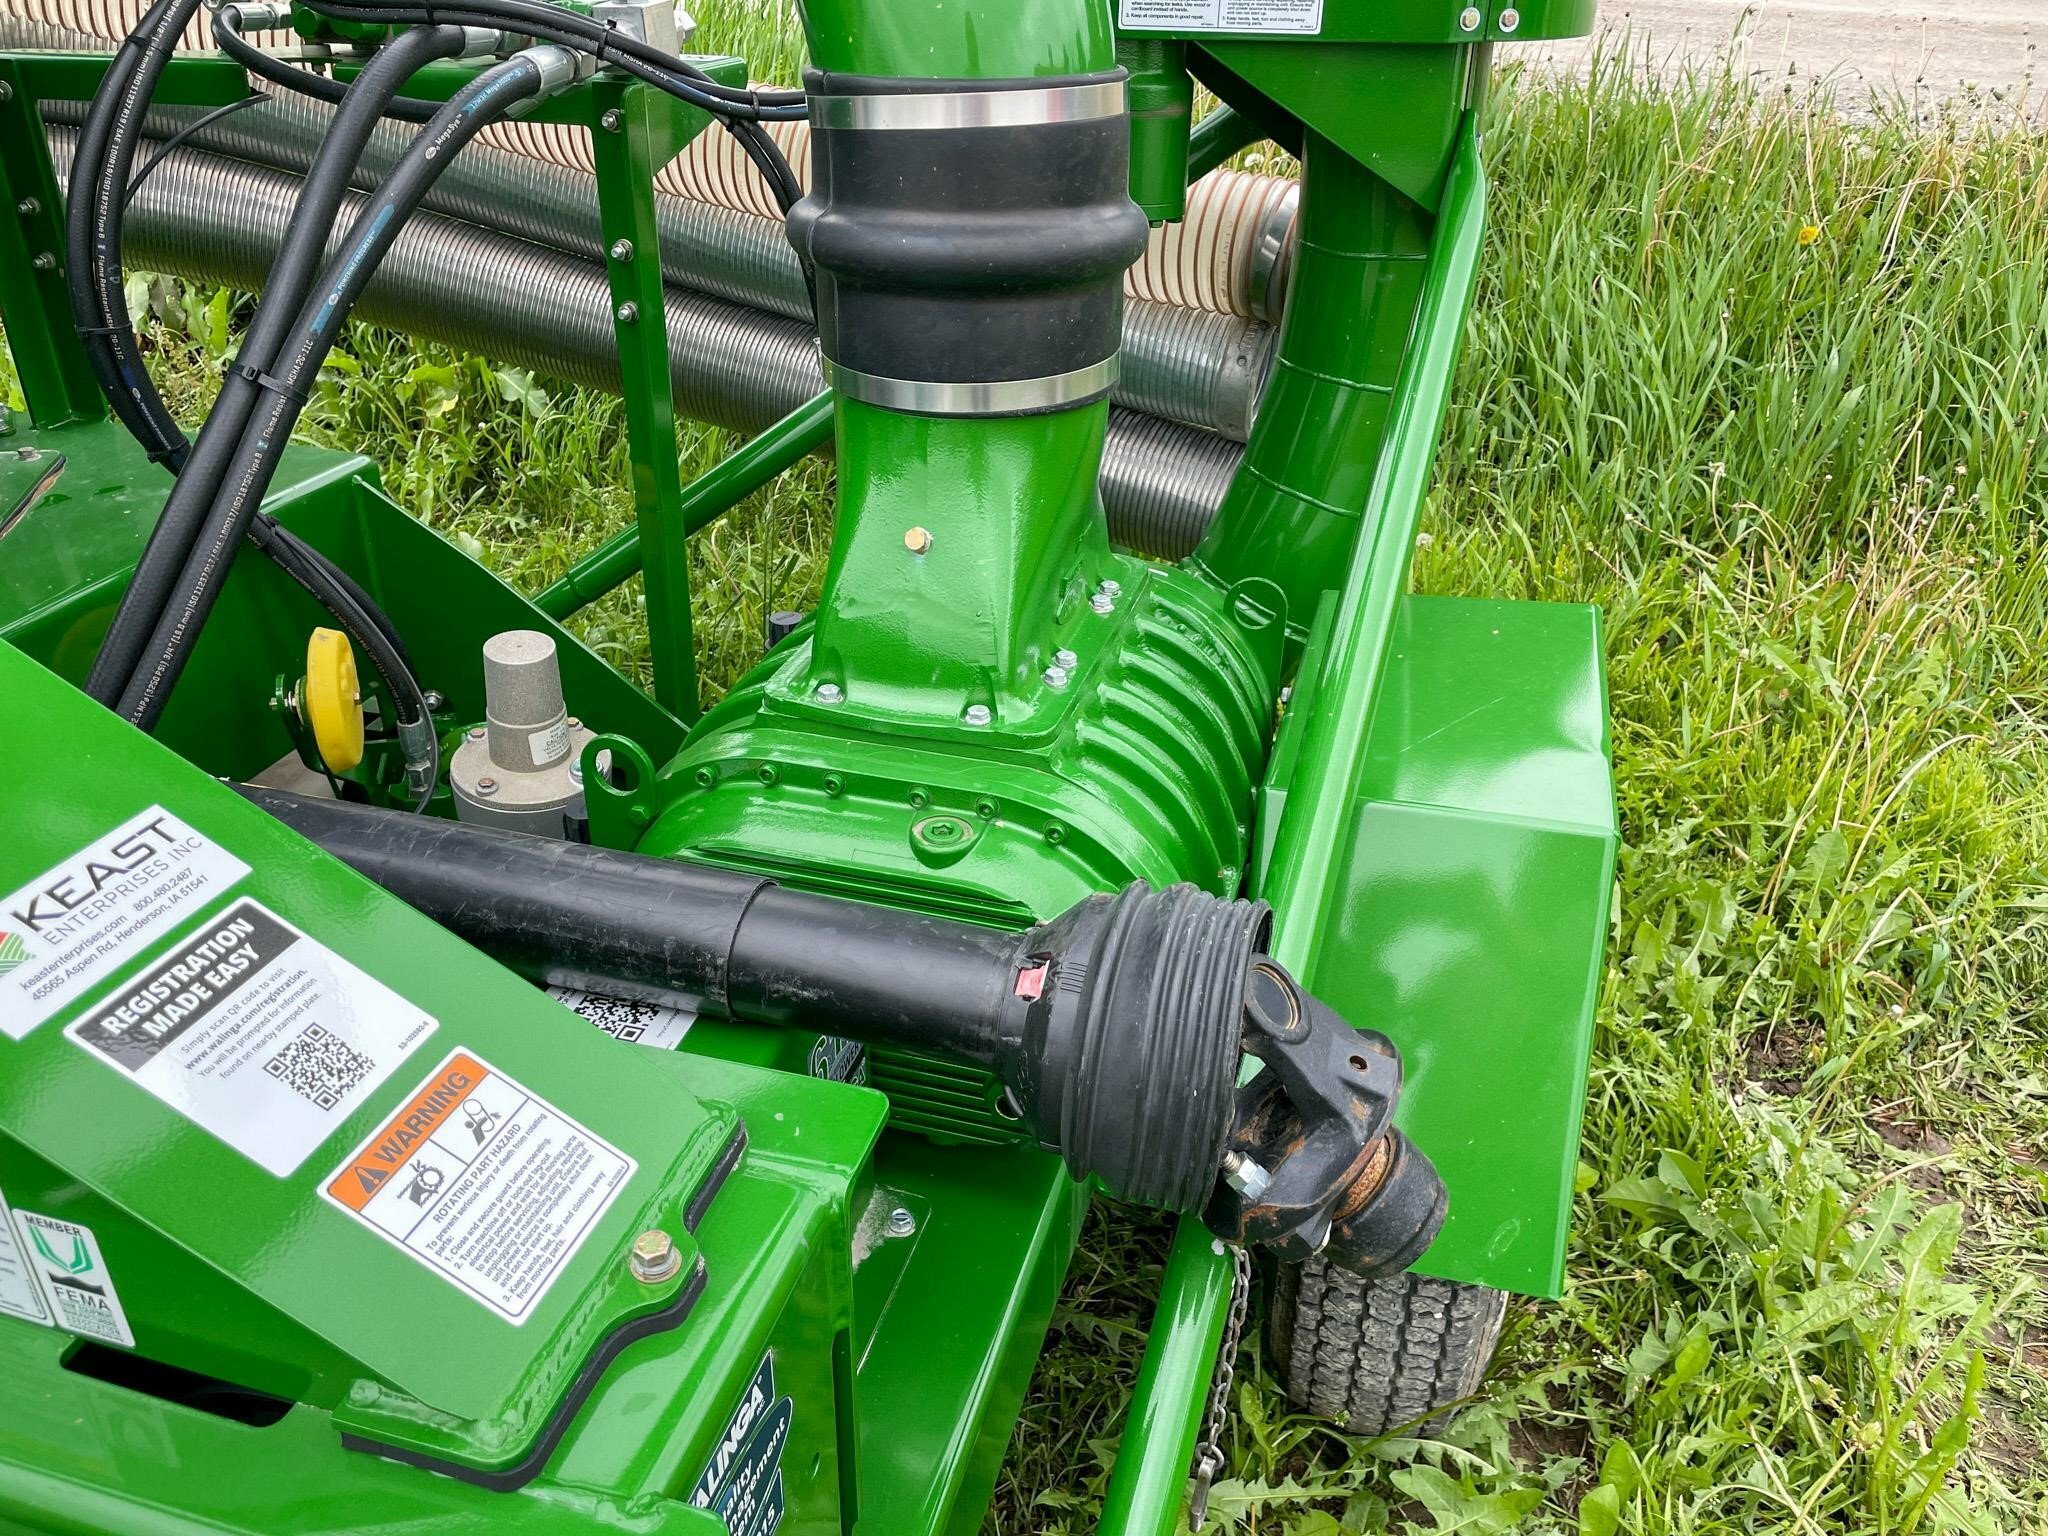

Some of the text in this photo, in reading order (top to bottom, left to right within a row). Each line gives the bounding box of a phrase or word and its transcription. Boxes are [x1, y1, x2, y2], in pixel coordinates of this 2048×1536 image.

[124, 84, 139, 109] 11237
[132, 71, 144, 85] ISO
[97, 215, 106, 232] Type
[99, 190, 109, 215] 18752
[99, 277, 110, 312] Resistant
[261, 338, 314, 438] Flame MSHA 2G-11C
[187, 593, 199, 608] ISO
[193, 571, 209, 596] 11237
[237, 472, 254, 497] 18752
[247, 457, 261, 474] Type
[254, 451, 263, 459] B
[11, 817, 174, 931] KEAST
[42, 836, 203, 945] ENTERPRISES INC
[19, 866, 192, 990] keastenterprises.com 800.480.2487
[31, 873, 209, 1001] 45565 Aspen Rd, Henderson, IA 51541
[101, 918, 253, 1034] REGISTRATION
[142, 942, 259, 1037] MADE EASY
[180, 967, 287, 1054] Simply scan QR code to visit
[184, 969, 307, 1069] www.walinga.com/registration.
[197, 977, 318, 1077] You will be prompted for information
[218, 992, 323, 1079] found on nearby stamped plate.
[373, 1071, 470, 1163] WARNING
[425, 1112, 548, 1250] To prevent serious injury or death from rotating
[432, 1123, 521, 1223] ROTATING PART HAZARD
[449, 1235, 469, 1255] Close
[466, 1221, 480, 1237] and
[476, 1201, 498, 1224] secure
[494, 1182, 512, 1203] guard
[508, 1164, 528, 1185] before
[525, 1137, 552, 1166] operating.
[452, 1152, 552, 1270] 2. Turn machine off or lock-out tag-out
[468, 1134, 578, 1267] electrical power and wait for all moving parts
[474, 1140, 586, 1272] to stop before servicing, adjusting, repairing,
[483, 1146, 589, 1277] unplugging or maintaining unit. Ensure that
[491, 1153, 595, 1283] unit power source is completely shut down
[24, 1214, 81, 1237] MEMBER
[434, 1234, 455, 1257] parts:
[499, 1222, 553, 1288] and can not start up.
[501, 1170, 607, 1302] 3. Keep hands, feet, hair and clothing away
[515, 1238, 567, 1300] from moving parts.
[53, 1286, 112, 1311] FEMA
[693, 1384, 764, 1509] ALINGA
[730, 1417, 785, 1534] nagement
